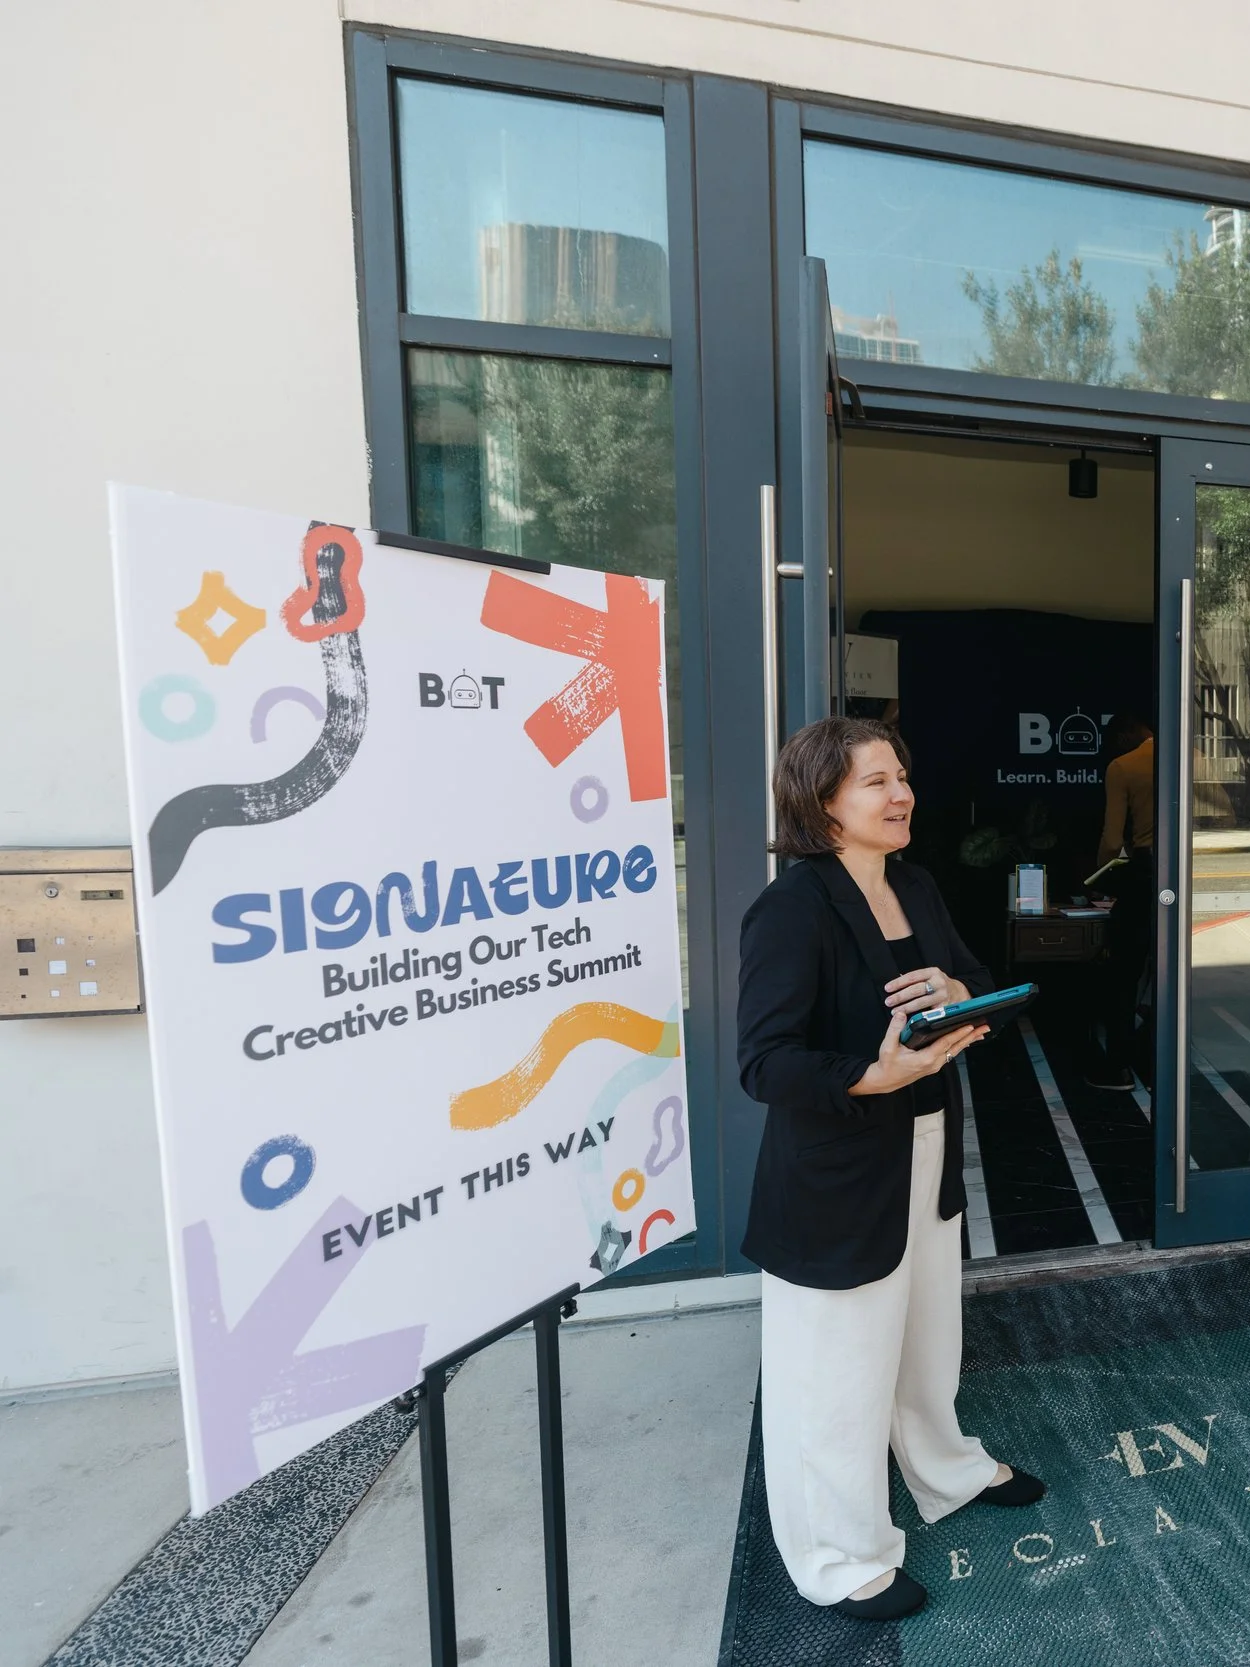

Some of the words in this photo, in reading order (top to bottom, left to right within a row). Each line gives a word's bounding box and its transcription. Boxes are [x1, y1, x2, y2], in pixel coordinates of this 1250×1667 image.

[996, 769, 1052, 784] Learn.
[1056, 769, 1103, 784] Build.
[322, 947, 463, 998] Building
[468, 934, 527, 967] Our
[530, 917, 592, 954] Tech
[242, 1006, 409, 1061] Creative
[415, 973, 541, 1022] Business
[546, 945, 642, 989] Summit
[321, 1185, 444, 1264] EVENT
[460, 1152, 531, 1200] THIS
[543, 1116, 615, 1164] WAY
[948, 1505, 1180, 1581] EOLA
